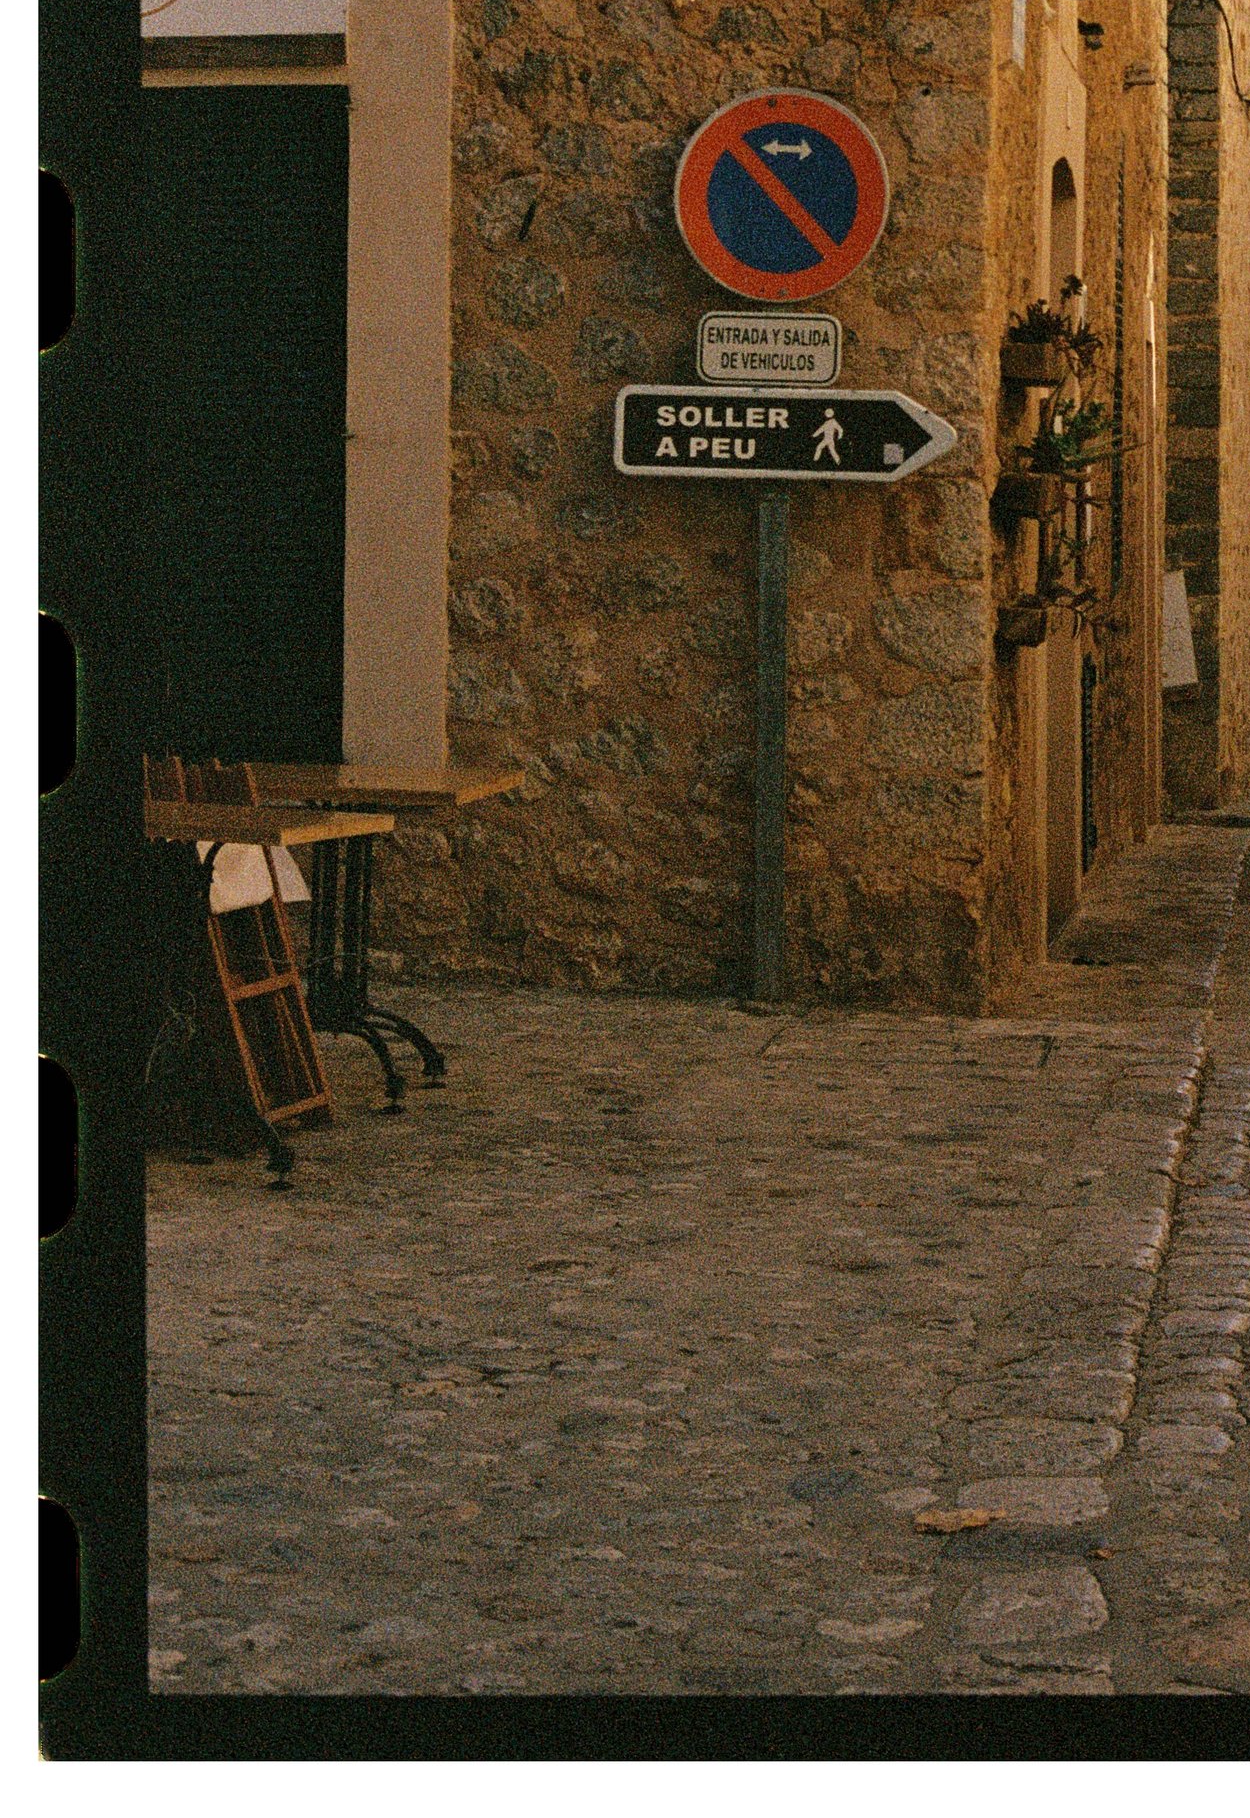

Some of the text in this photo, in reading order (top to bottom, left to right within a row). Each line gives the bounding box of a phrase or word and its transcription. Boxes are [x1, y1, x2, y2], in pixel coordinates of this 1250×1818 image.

[708, 327, 830, 346] ENTRADA Y SALIDA
[721, 352, 815, 371] DE VEHICULOS
[656, 405, 789, 429] SOLLER
[655, 436, 756, 459] A PEU
